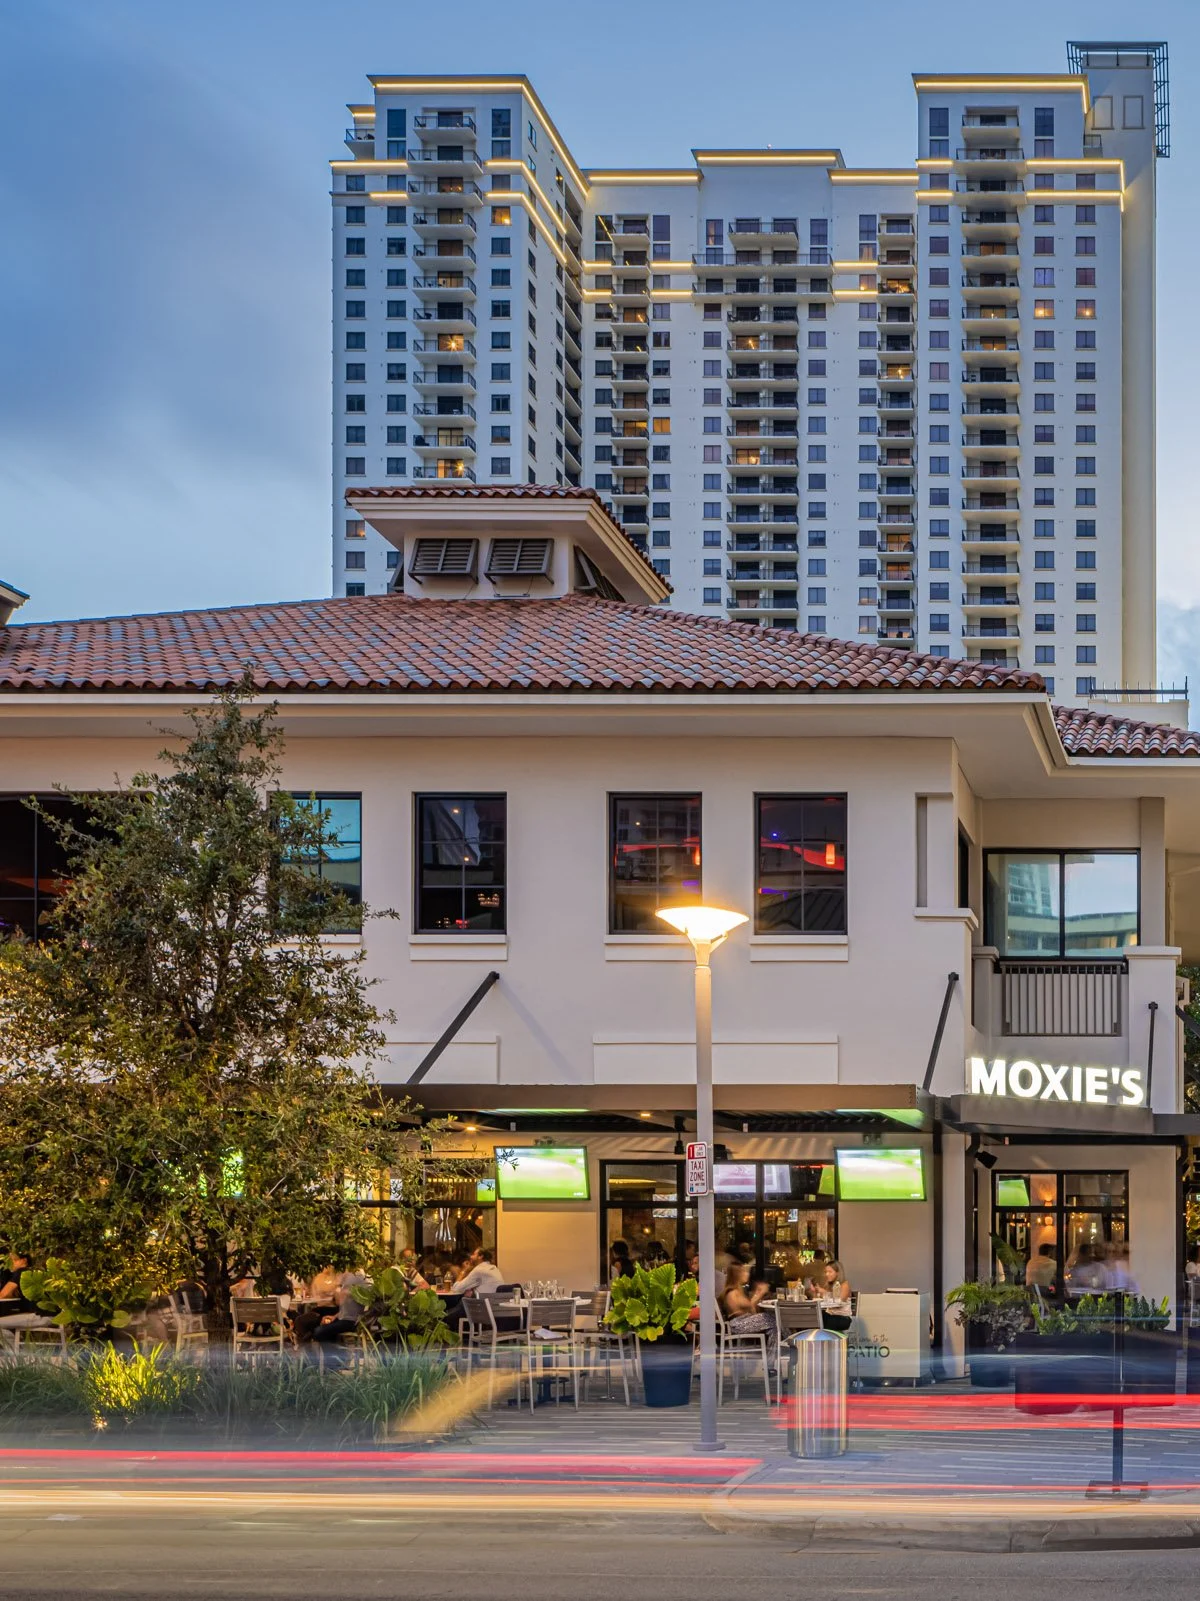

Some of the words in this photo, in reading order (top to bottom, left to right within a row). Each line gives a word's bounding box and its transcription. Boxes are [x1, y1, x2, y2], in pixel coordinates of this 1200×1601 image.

[970, 1056, 1144, 1106] MOXIE'S
[691, 1161, 704, 1170] TAXI
[690, 1172, 705, 1181] ZONE
[847, 1345, 890, 1358] PATIO
